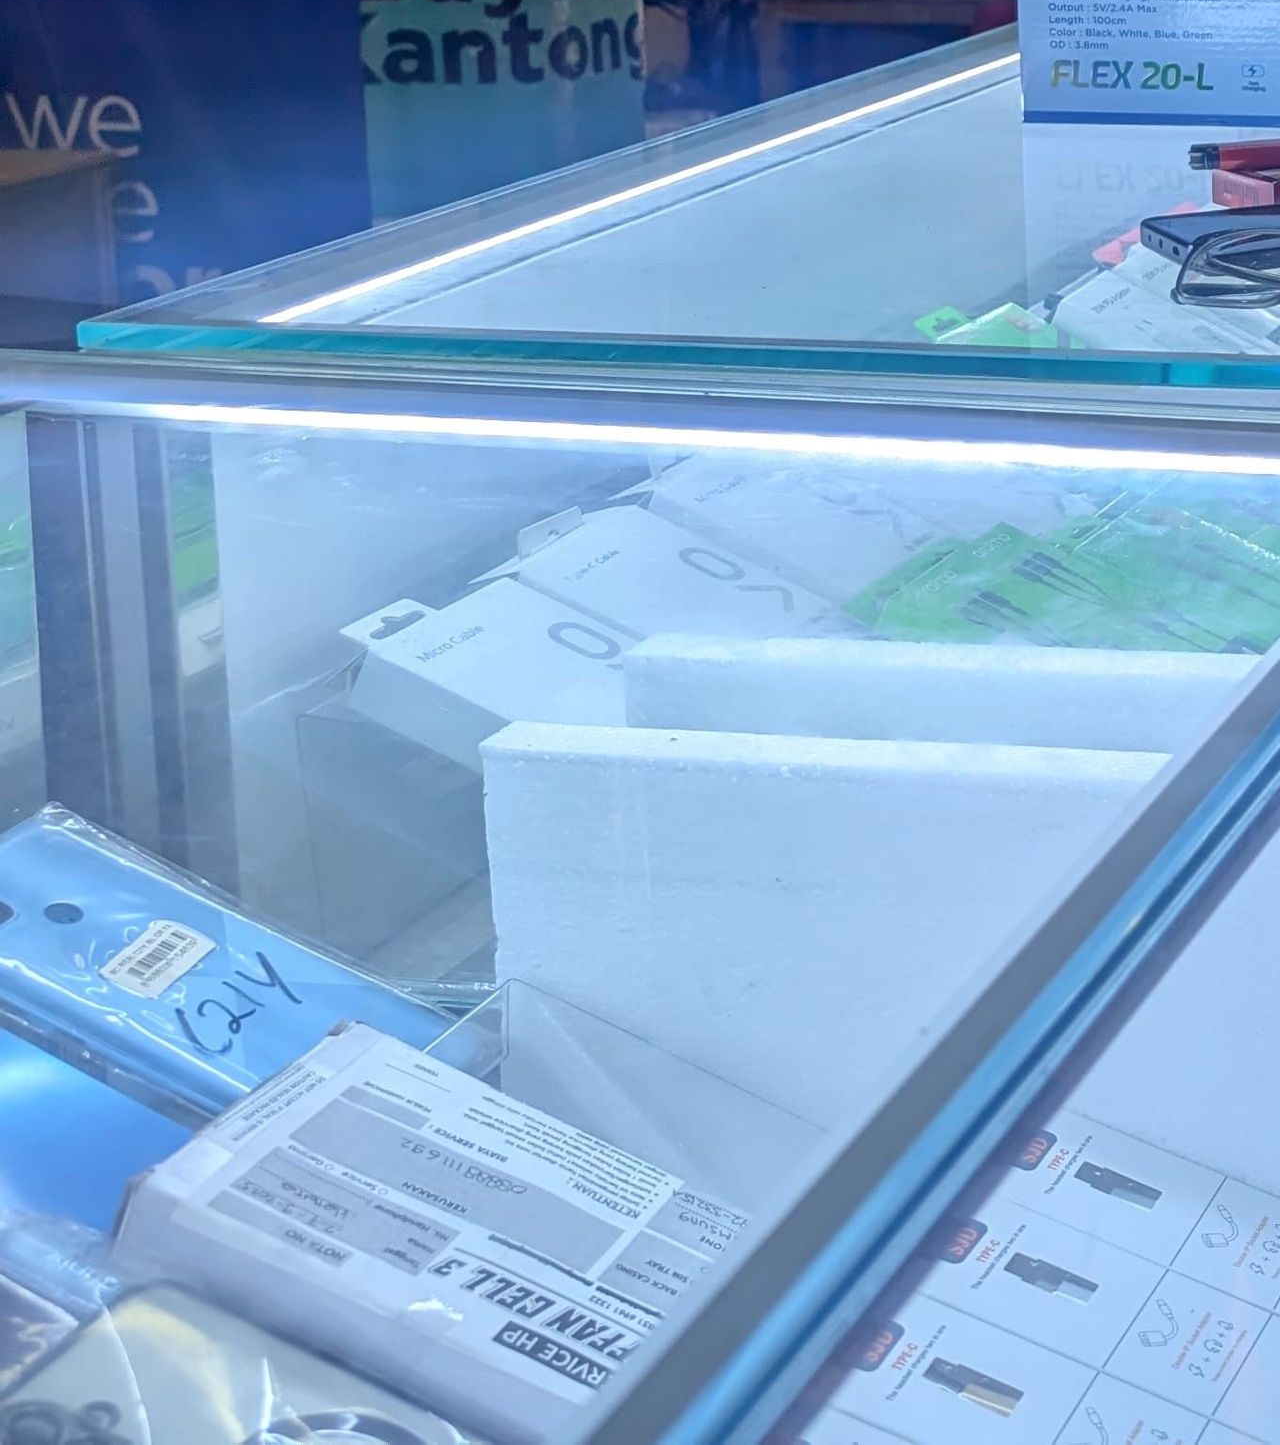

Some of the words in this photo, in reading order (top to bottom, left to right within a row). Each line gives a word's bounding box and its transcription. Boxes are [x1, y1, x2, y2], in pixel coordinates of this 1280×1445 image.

[1048, 3, 1084, 13] Output
[1093, 3, 1134, 13] 5V/2.4A
[1137, 4, 1157, 13] Max
[1049, 15, 1084, 26] Length
[1093, 16, 1127, 25] 100cm
[1050, 28, 1077, 37] Color
[1085, 28, 1116, 38] Black,
[1118, 29, 1152, 39] White,
[1050, 40, 1066, 49] OD
[1075, 41, 1109, 50] 3.8mm
[1051, 59, 1134, 89] FLEX
[1140, 61, 1214, 91] 20-L
[5, 94, 142, 158] we
[416, 640, 454, 663] Micro
[449, 624, 486, 647] Cable
[433, 1125, 476, 1149] SERVICE
[1047, 1147, 1070, 1172] TYPE-C
[401, 1179, 468, 1214] KERUSAKAN
[570, 1181, 641, 1219] KETENTUAN
[975, 1238, 1001, 1264] TYPE-C
[429, 1255, 468, 1277] 3
[613, 1262, 651, 1283] CASING
[459, 1268, 557, 1320] CELL
[499, 1323, 540, 1353] HP
[537, 1341, 610, 1386] RVICE
[891, 1342, 918, 1371] TYPE-C
